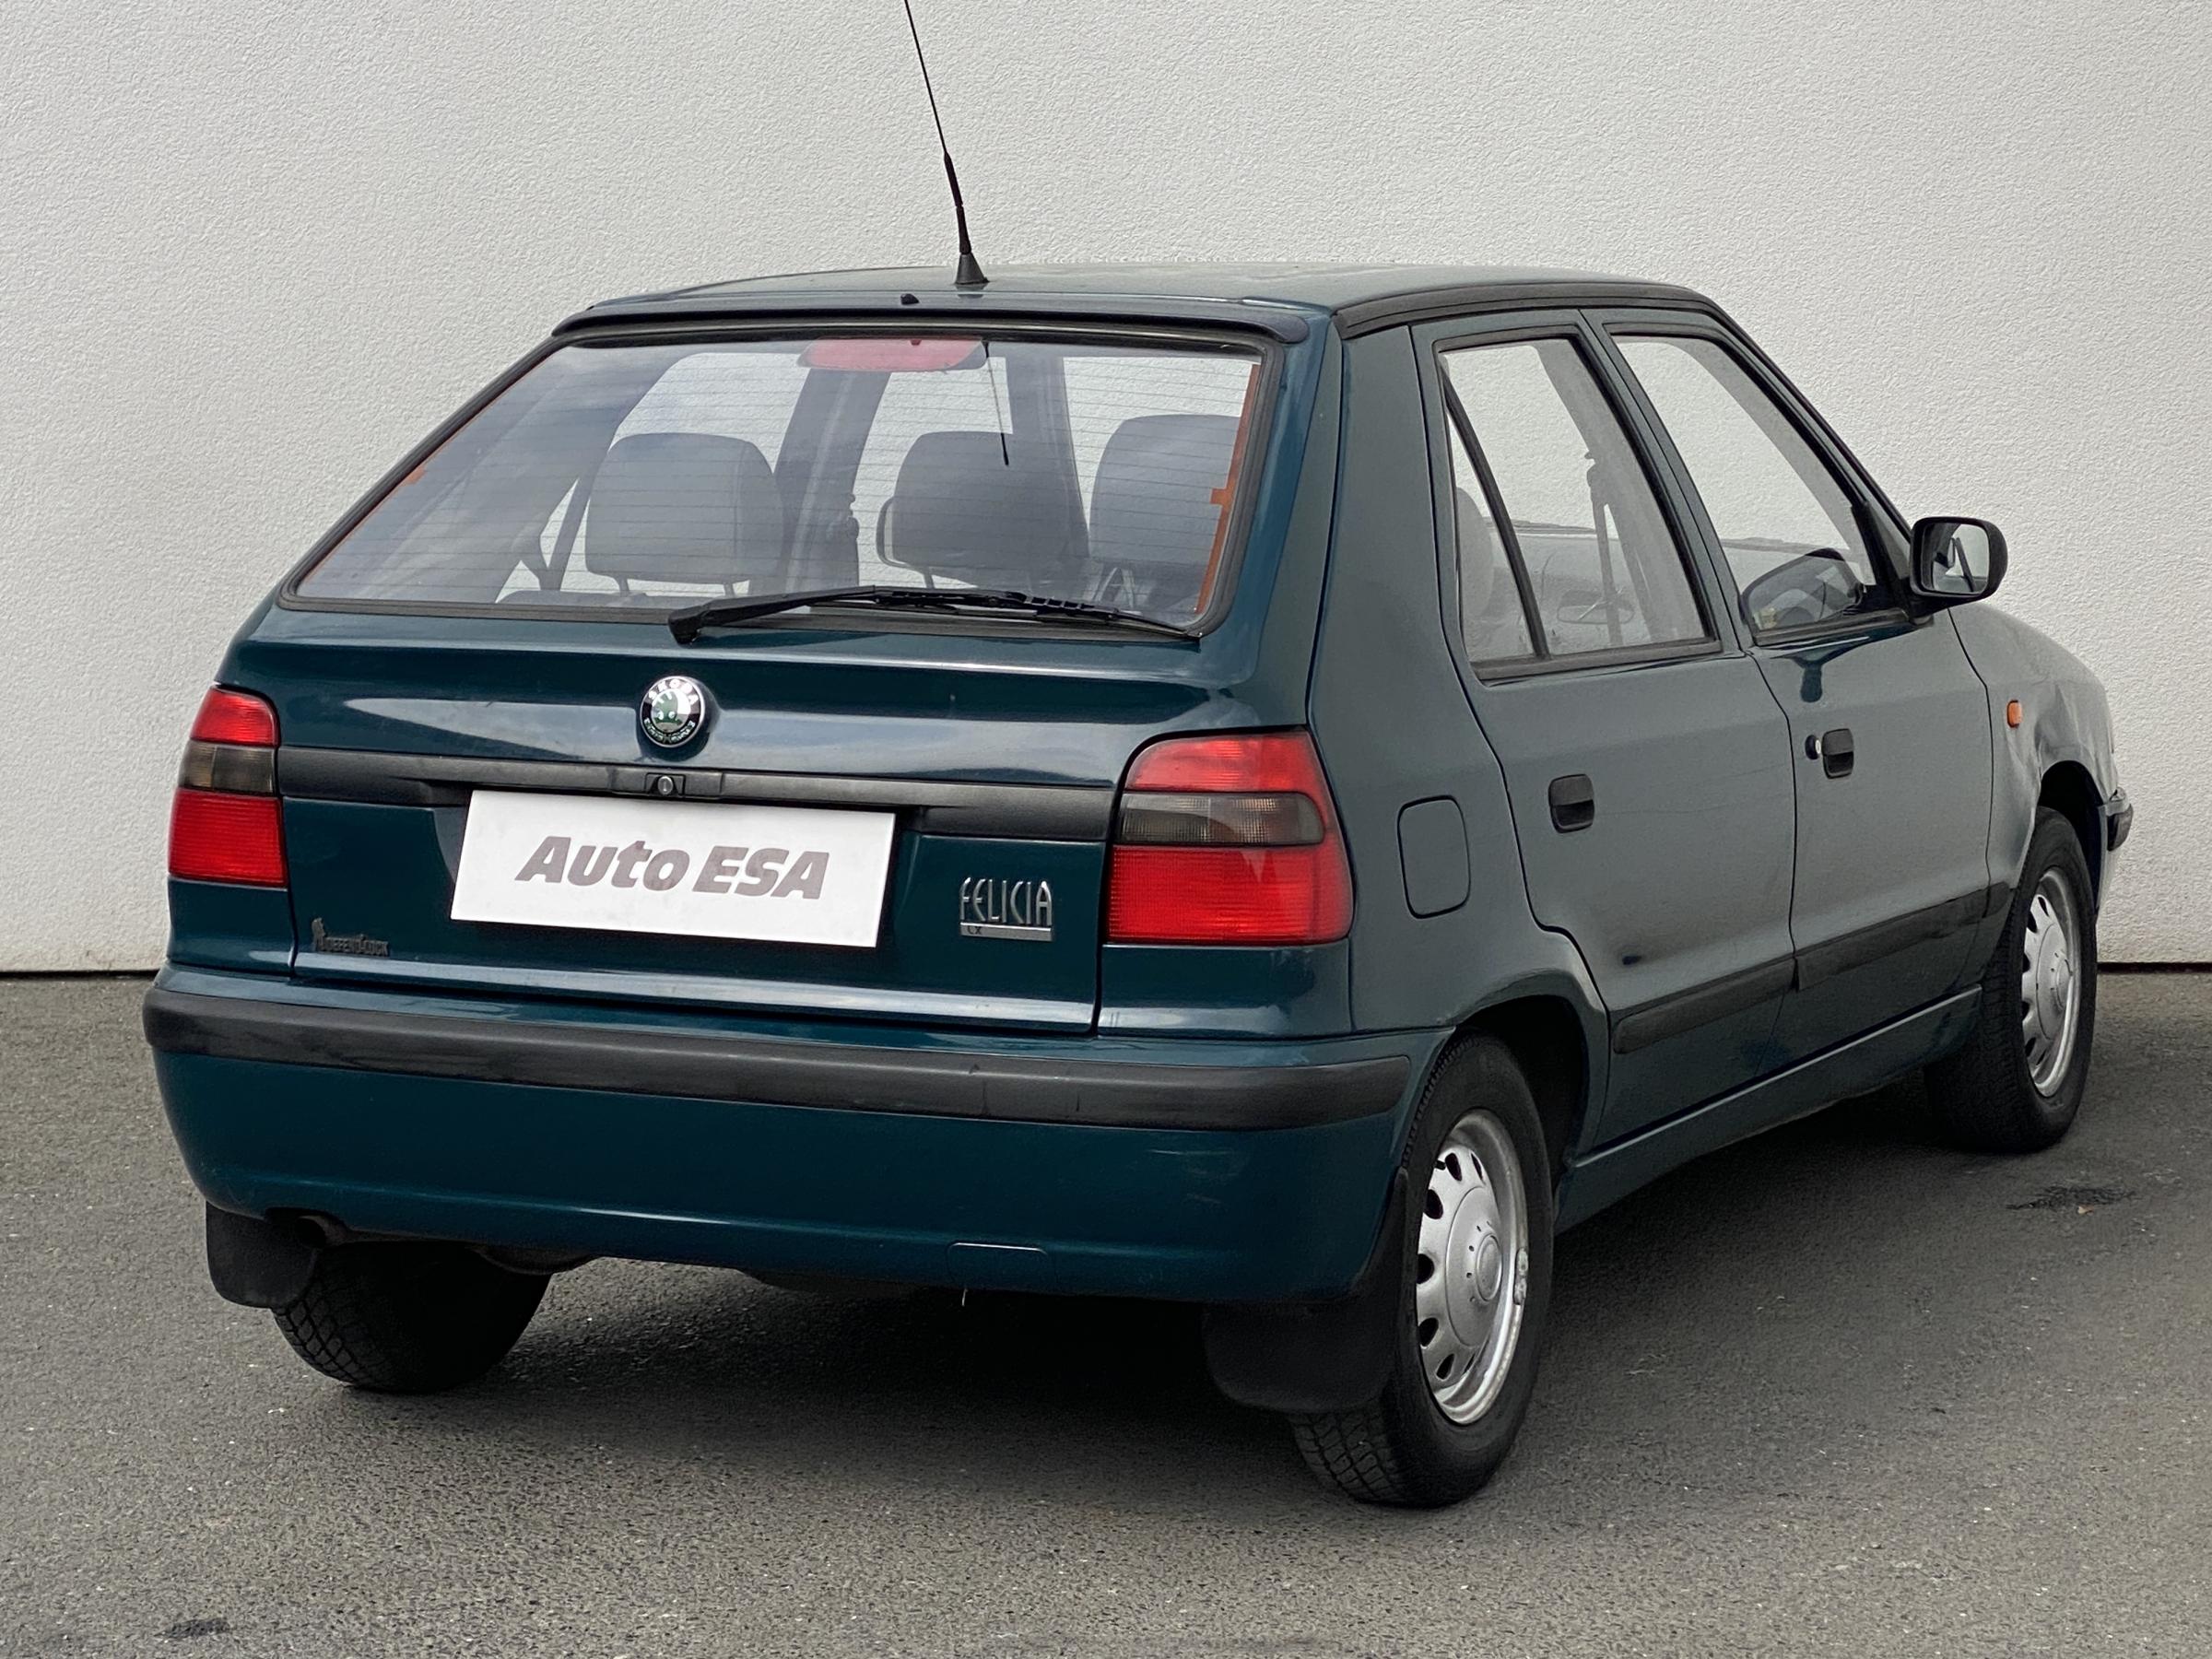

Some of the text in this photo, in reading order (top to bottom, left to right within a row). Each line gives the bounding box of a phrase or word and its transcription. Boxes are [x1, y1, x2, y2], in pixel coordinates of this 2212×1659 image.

[514, 835, 830, 900] Auto ESA
[959, 877, 1053, 926] FELICIA
